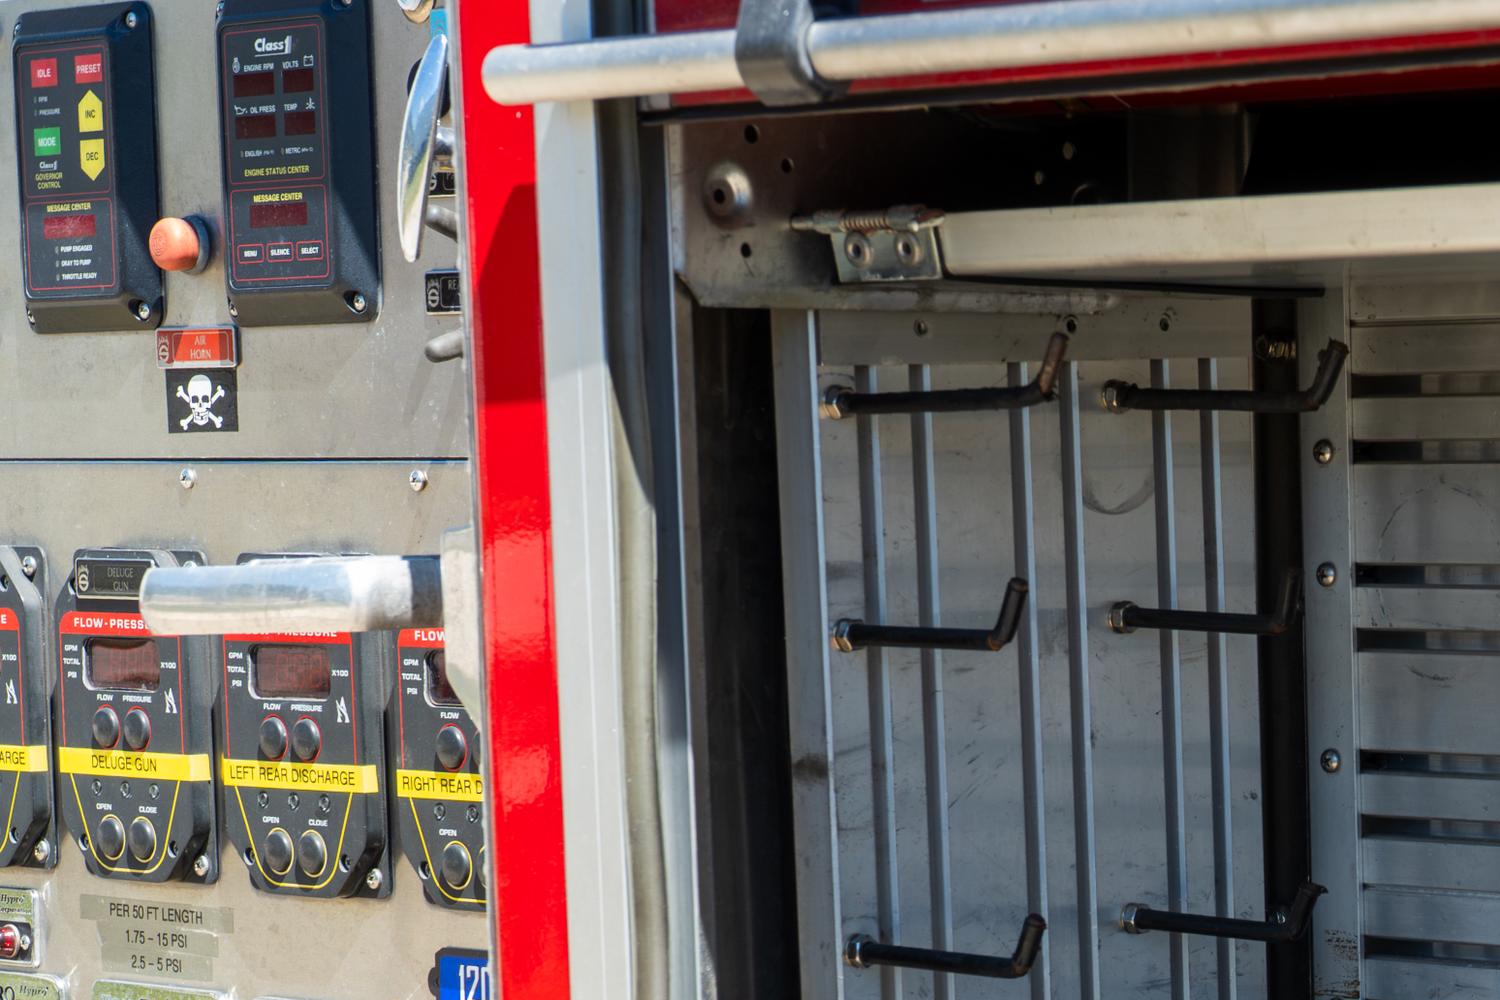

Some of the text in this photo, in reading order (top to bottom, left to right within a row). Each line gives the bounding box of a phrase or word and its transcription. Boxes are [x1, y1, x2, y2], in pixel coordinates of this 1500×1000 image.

[76, 63, 101, 74] PRESET
[243, 62, 274, 72] ENGINE RPM
[282, 60, 299, 69] VOLTS
[37, 68, 51, 78] IDLE
[250, 105, 276, 114] OIL PRESS
[284, 103, 297, 111] TEMP
[85, 109, 96, 119] INC
[38, 137, 56, 147] MODE
[86, 152, 99, 161] DEC
[244, 165, 309, 177] ENGINE STATUS CENTER
[35, 172, 62, 181] GOVERNOR
[37, 182, 61, 190] CONTROL
[253, 192, 303, 203] MESSAGE CENTER
[47, 202, 91, 212] MESSAGE CENTER
[270, 248, 291, 256] SILENCE
[301, 246, 320, 254] SELECT
[194, 335, 206, 346] AIR
[190, 348, 212, 360] HORN
[107, 567, 133, 579] DELUGE
[112, 582, 129, 592] GUN
[63, 657, 80, 665] TOTAL
[331, 669, 349, 677] X100
[402, 673, 422, 681] TOTAL
[96, 693, 113, 701] FLOW
[122, 694, 152, 703] PRESSURE
[263, 703, 281, 711] FLOW
[290, 704, 323, 713] PRESSURE
[440, 712, 459, 720] FLOW
[91, 754, 157, 772] DELUGE GUN
[230, 765, 355, 786] LEFT REAR DISCHARGE
[402, 776, 436, 792] RIGHT
[440, 778, 471, 794] REAR
[96, 803, 112, 811] OPEN
[138, 806, 157, 814] CLOSE
[262, 816, 279, 824] OPEN
[308, 819, 328, 827] CLOSE
[439, 829, 457, 837] OPEN
[109, 902, 203, 925] PER 50 FT LENGTH
[125, 929, 146, 945] 1.75
[156, 931, 168, 946] 15
[171, 933, 187, 948] PSI
[131, 955, 146, 969] 2.5
[157, 957, 163, 971] 5
[166, 958, 182, 972] PSI
